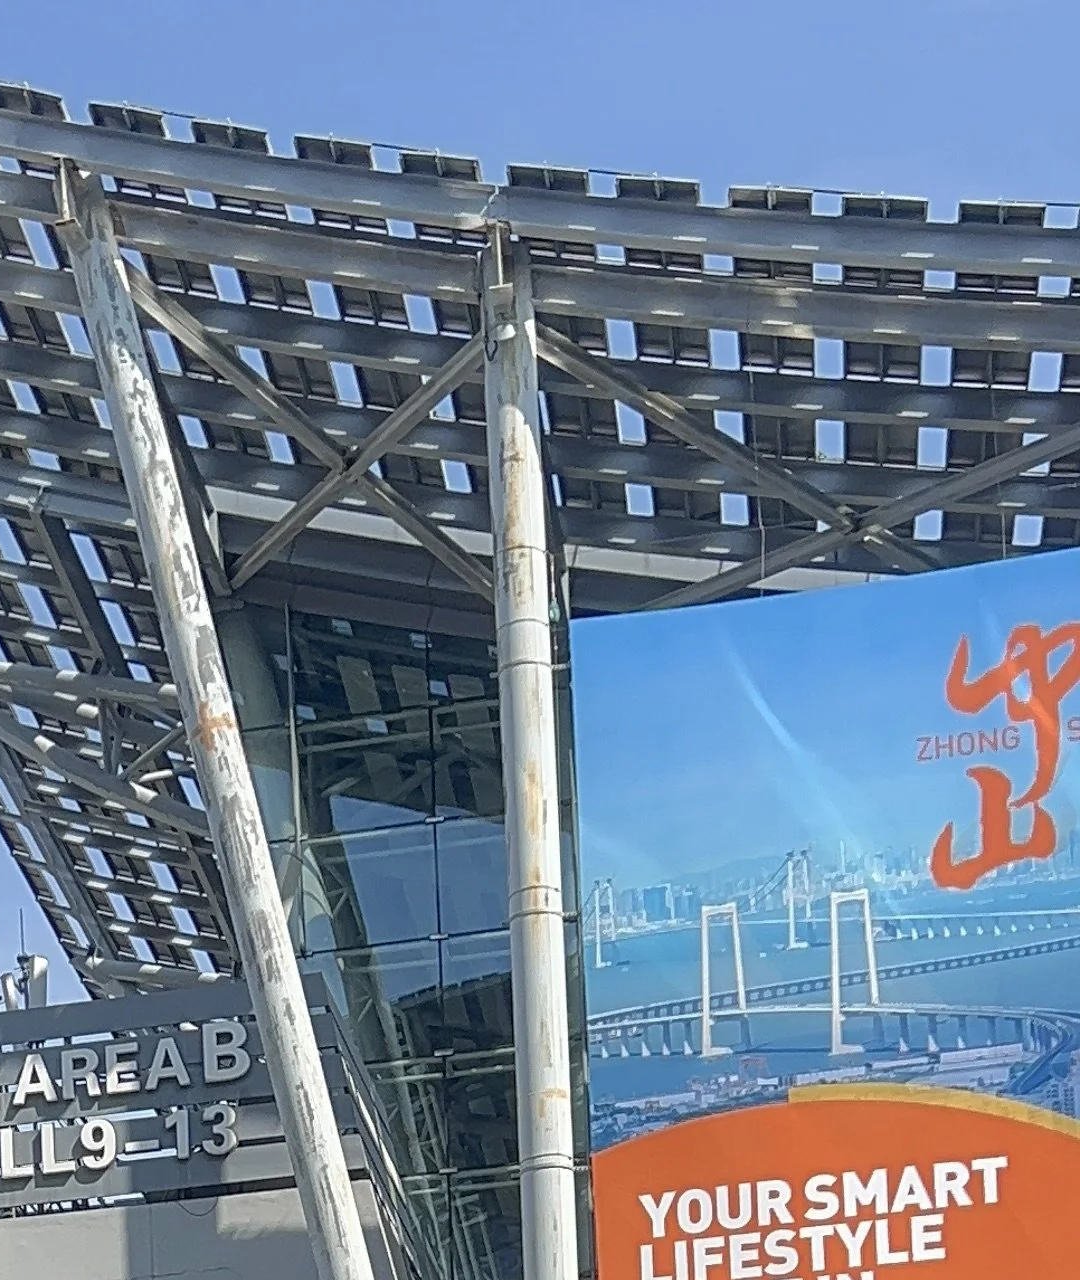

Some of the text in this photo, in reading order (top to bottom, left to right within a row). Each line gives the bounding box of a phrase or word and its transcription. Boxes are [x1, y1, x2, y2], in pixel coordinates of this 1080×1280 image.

[916, 726, 1020, 762] ZHONG
[638, 1155, 1009, 1239] YOUR SMART
